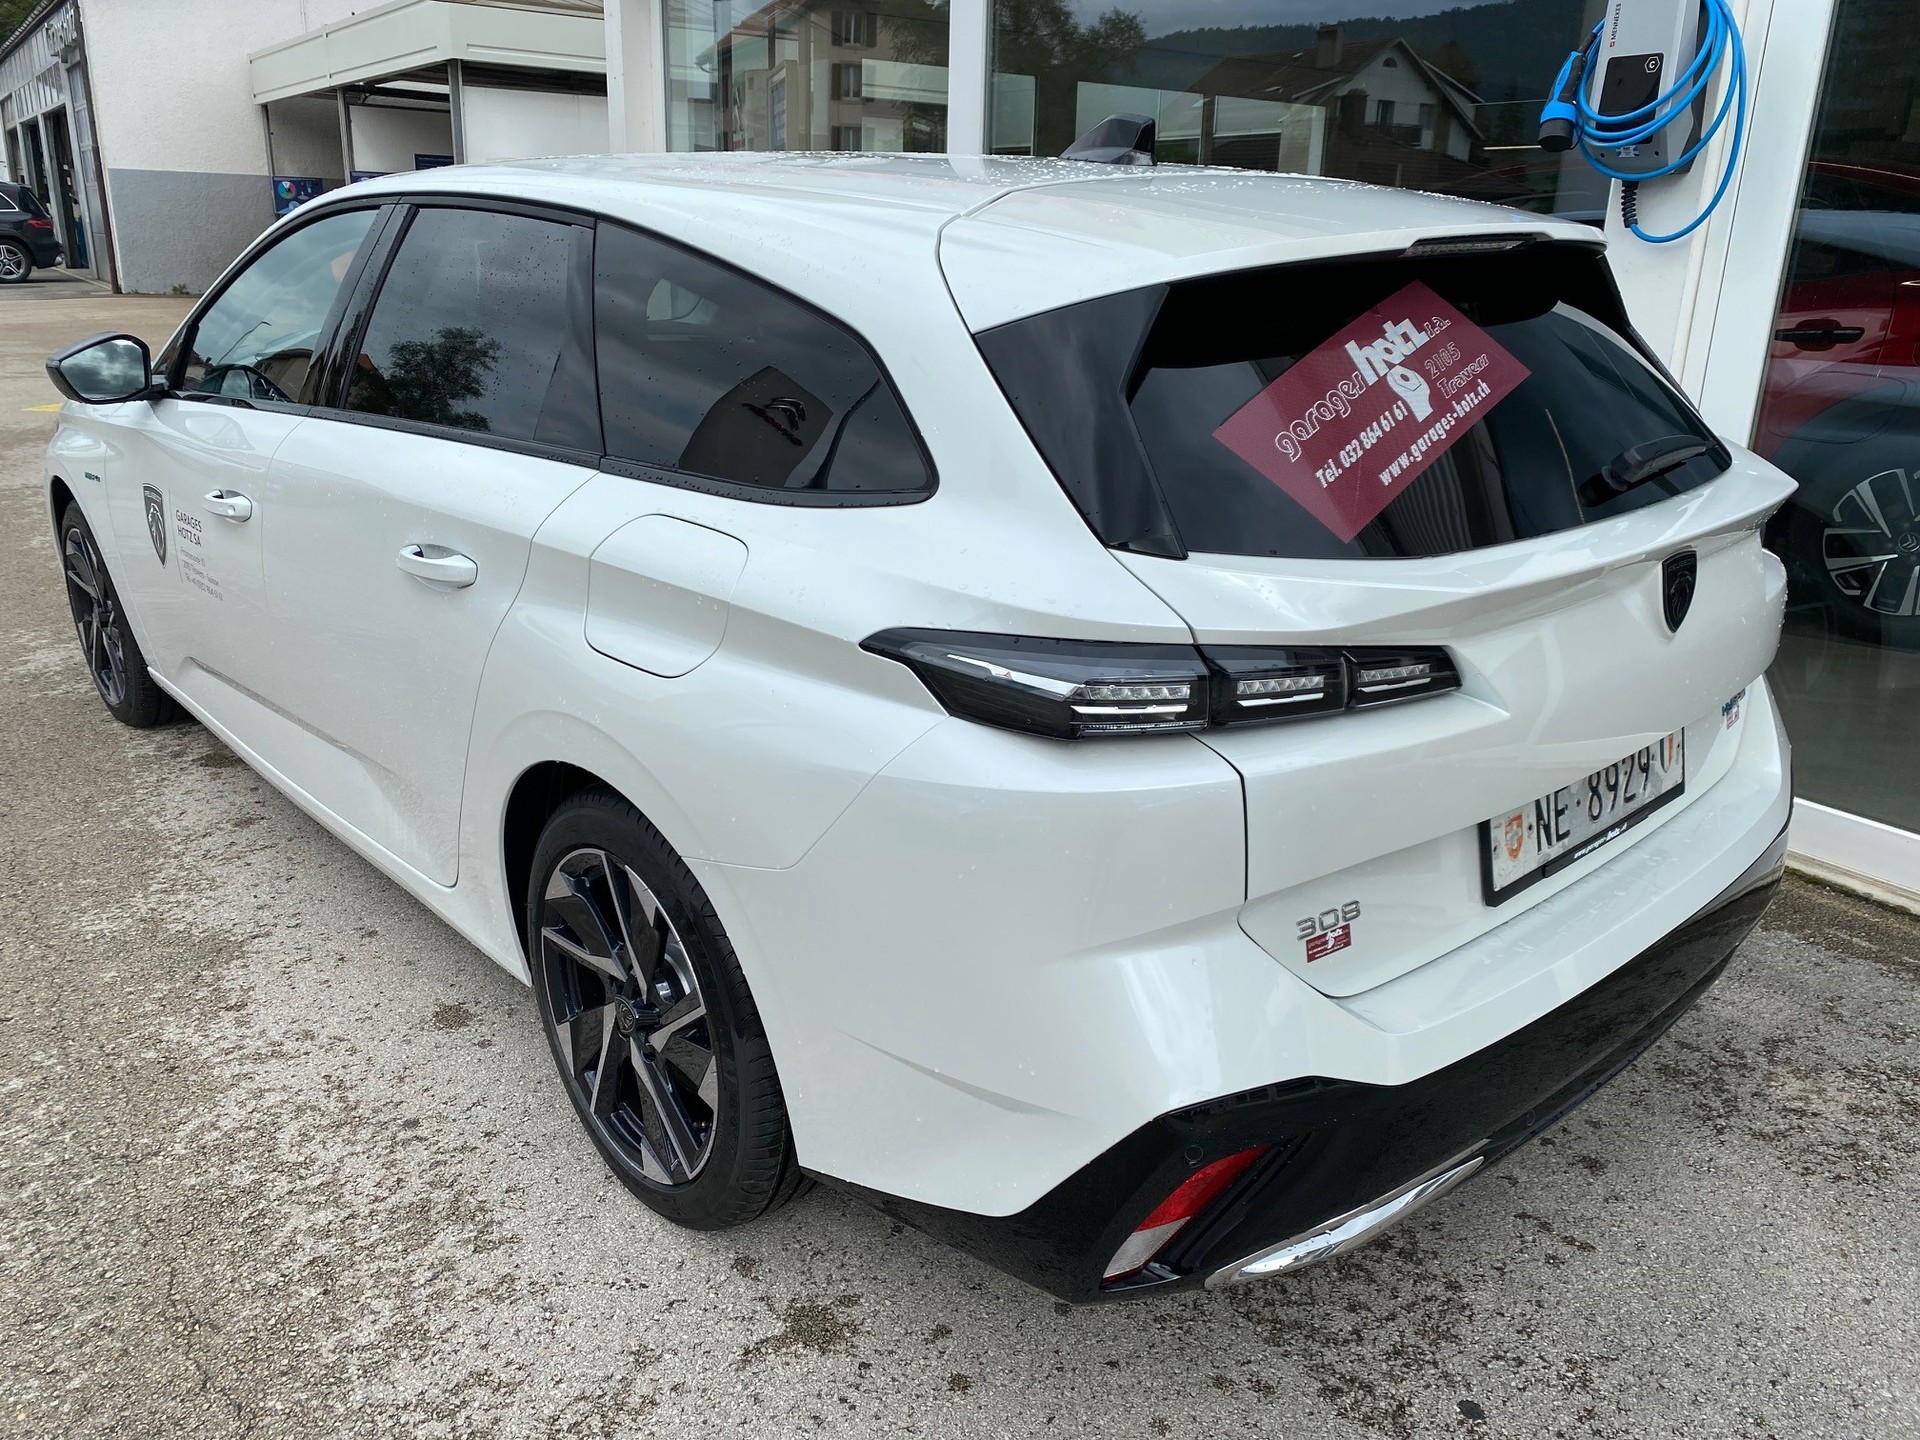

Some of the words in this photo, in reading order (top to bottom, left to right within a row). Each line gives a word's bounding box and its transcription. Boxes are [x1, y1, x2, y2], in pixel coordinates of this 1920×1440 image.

[1611, 3, 1621, 40] MENNEKES
[1424, 341, 1461, 380] 2105
[1436, 353, 1490, 399] Travers
[1274, 371, 1366, 462] garages
[1344, 318, 1430, 386] hotz
[1339, 438, 1363, 468] 032
[1360, 421, 1383, 449] 864
[1380, 410, 1396, 432] 61
[1393, 400, 1408, 421] 61
[1379, 379, 1491, 486] www.garages-hotz.ch
[176, 509, 202, 533] GARAGES
[1535, 785, 1571, 853] NE
[1587, 745, 1650, 822] 8929
[1296, 900, 1360, 941] 308
